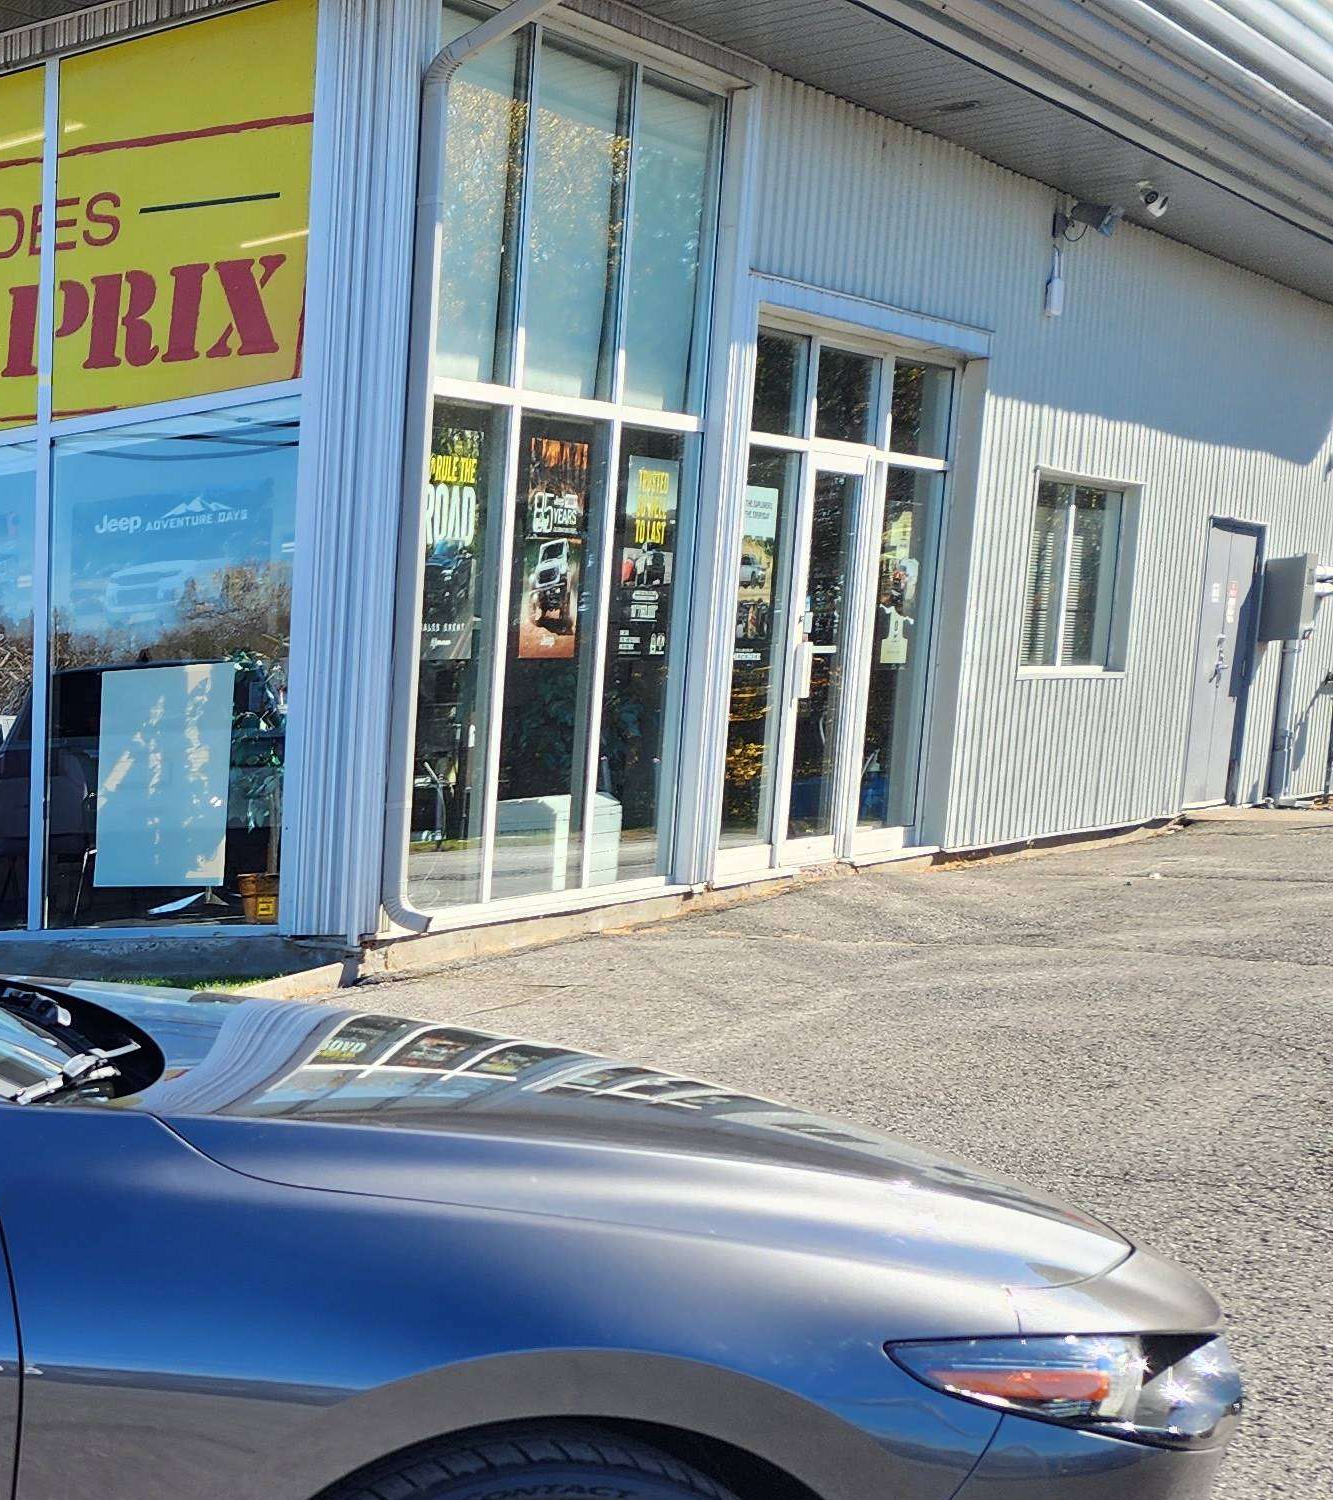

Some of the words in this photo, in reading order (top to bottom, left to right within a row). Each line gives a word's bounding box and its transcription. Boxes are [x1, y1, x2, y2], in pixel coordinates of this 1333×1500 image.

[2, 254, 287, 379] PRIX
[460, 456, 477, 483] THE
[94, 514, 142, 534] Jeep
[145, 512, 213, 531] ADVENTURE
[218, 509, 248, 523] DAYS
[425, 483, 476, 546] ROAD
[553, 508, 576, 525] YEARS
